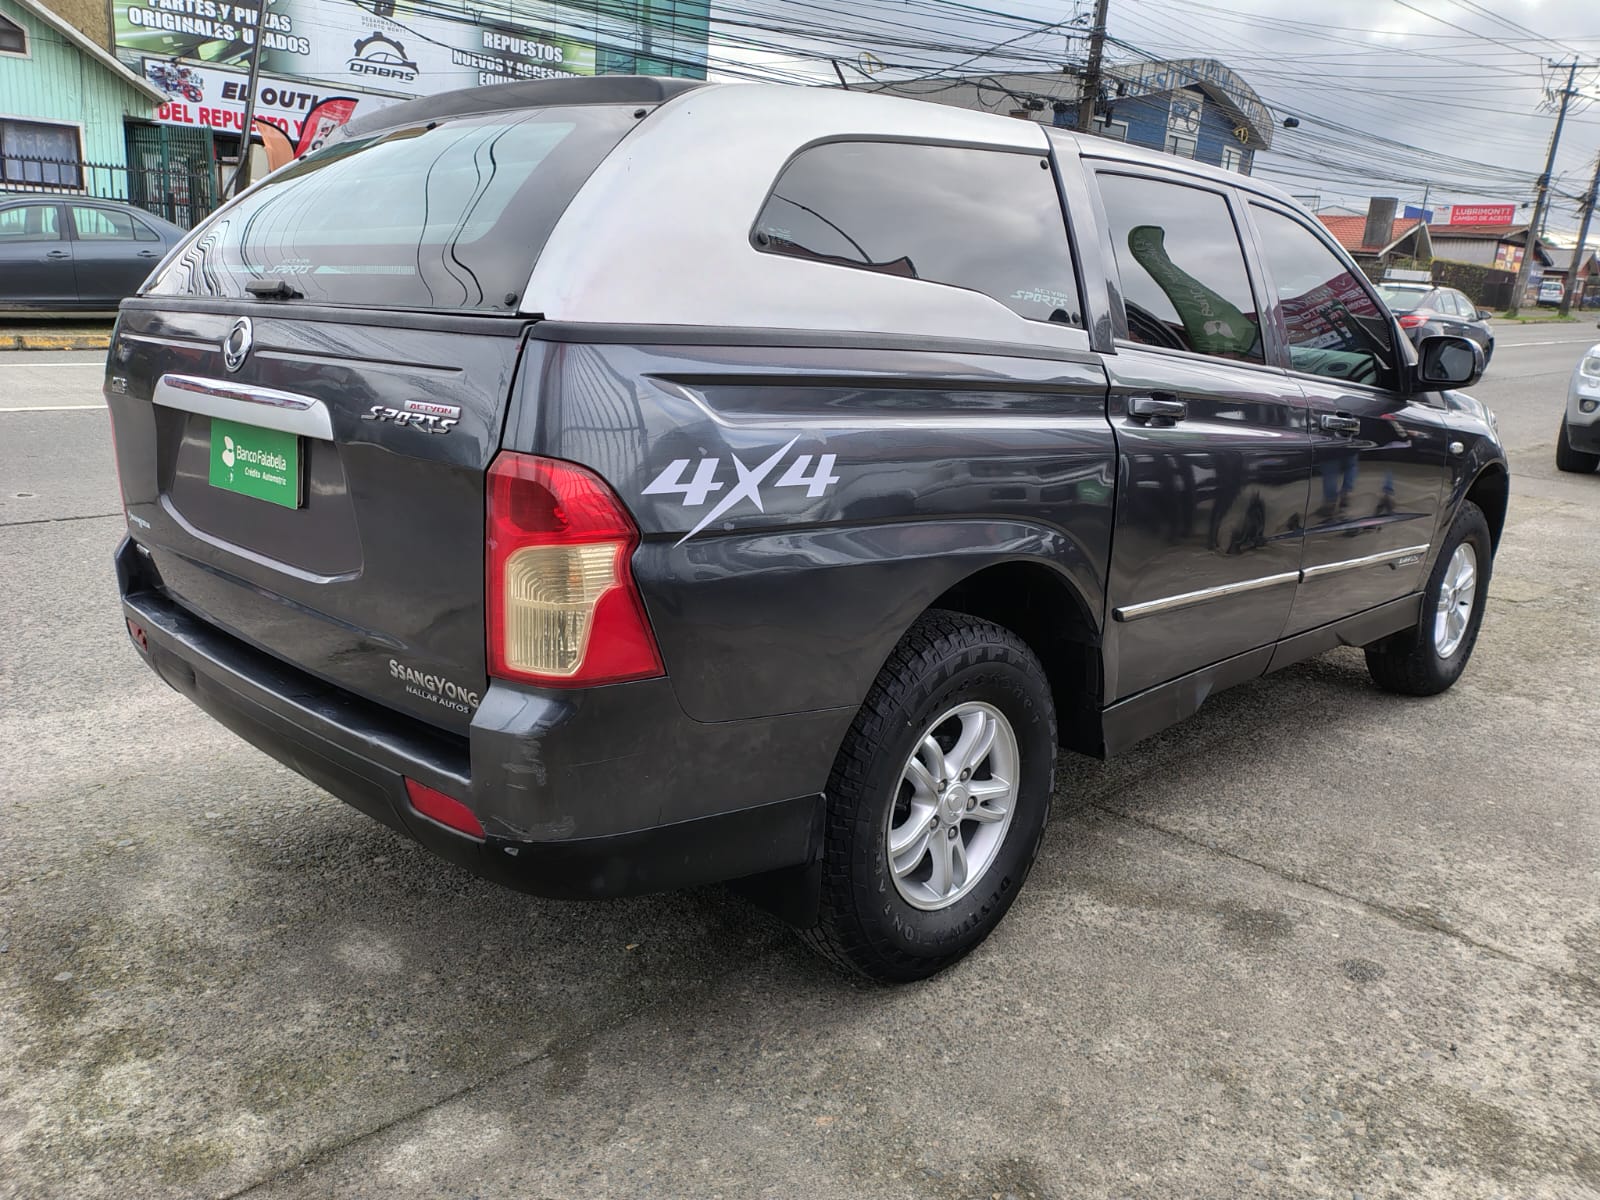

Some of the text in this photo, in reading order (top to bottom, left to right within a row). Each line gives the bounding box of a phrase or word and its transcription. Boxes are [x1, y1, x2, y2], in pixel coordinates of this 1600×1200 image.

[219, 4, 231, 19] Y
[128, 7, 310, 55] ORIGINALES UADOS
[483, 31, 563, 63] REPUESTOS
[349, 62, 416, 80] DABAS
[452, 49, 582, 80] NUEVOS Y ACCESO
[221, 81, 318, 110] EL OUT
[158, 103, 193, 123] DEL
[1455, 207, 1512, 216] LUBRIMONTT
[1010, 289, 1068, 307] SPORTS
[361, 406, 460, 434] SPORTS
[409, 403, 452, 414] ACTYON
[236, 445, 286, 471] Banco Falabella
[389, 659, 479, 709] SSANGYONG
[406, 685, 469, 714] HALLAR AUTOS
